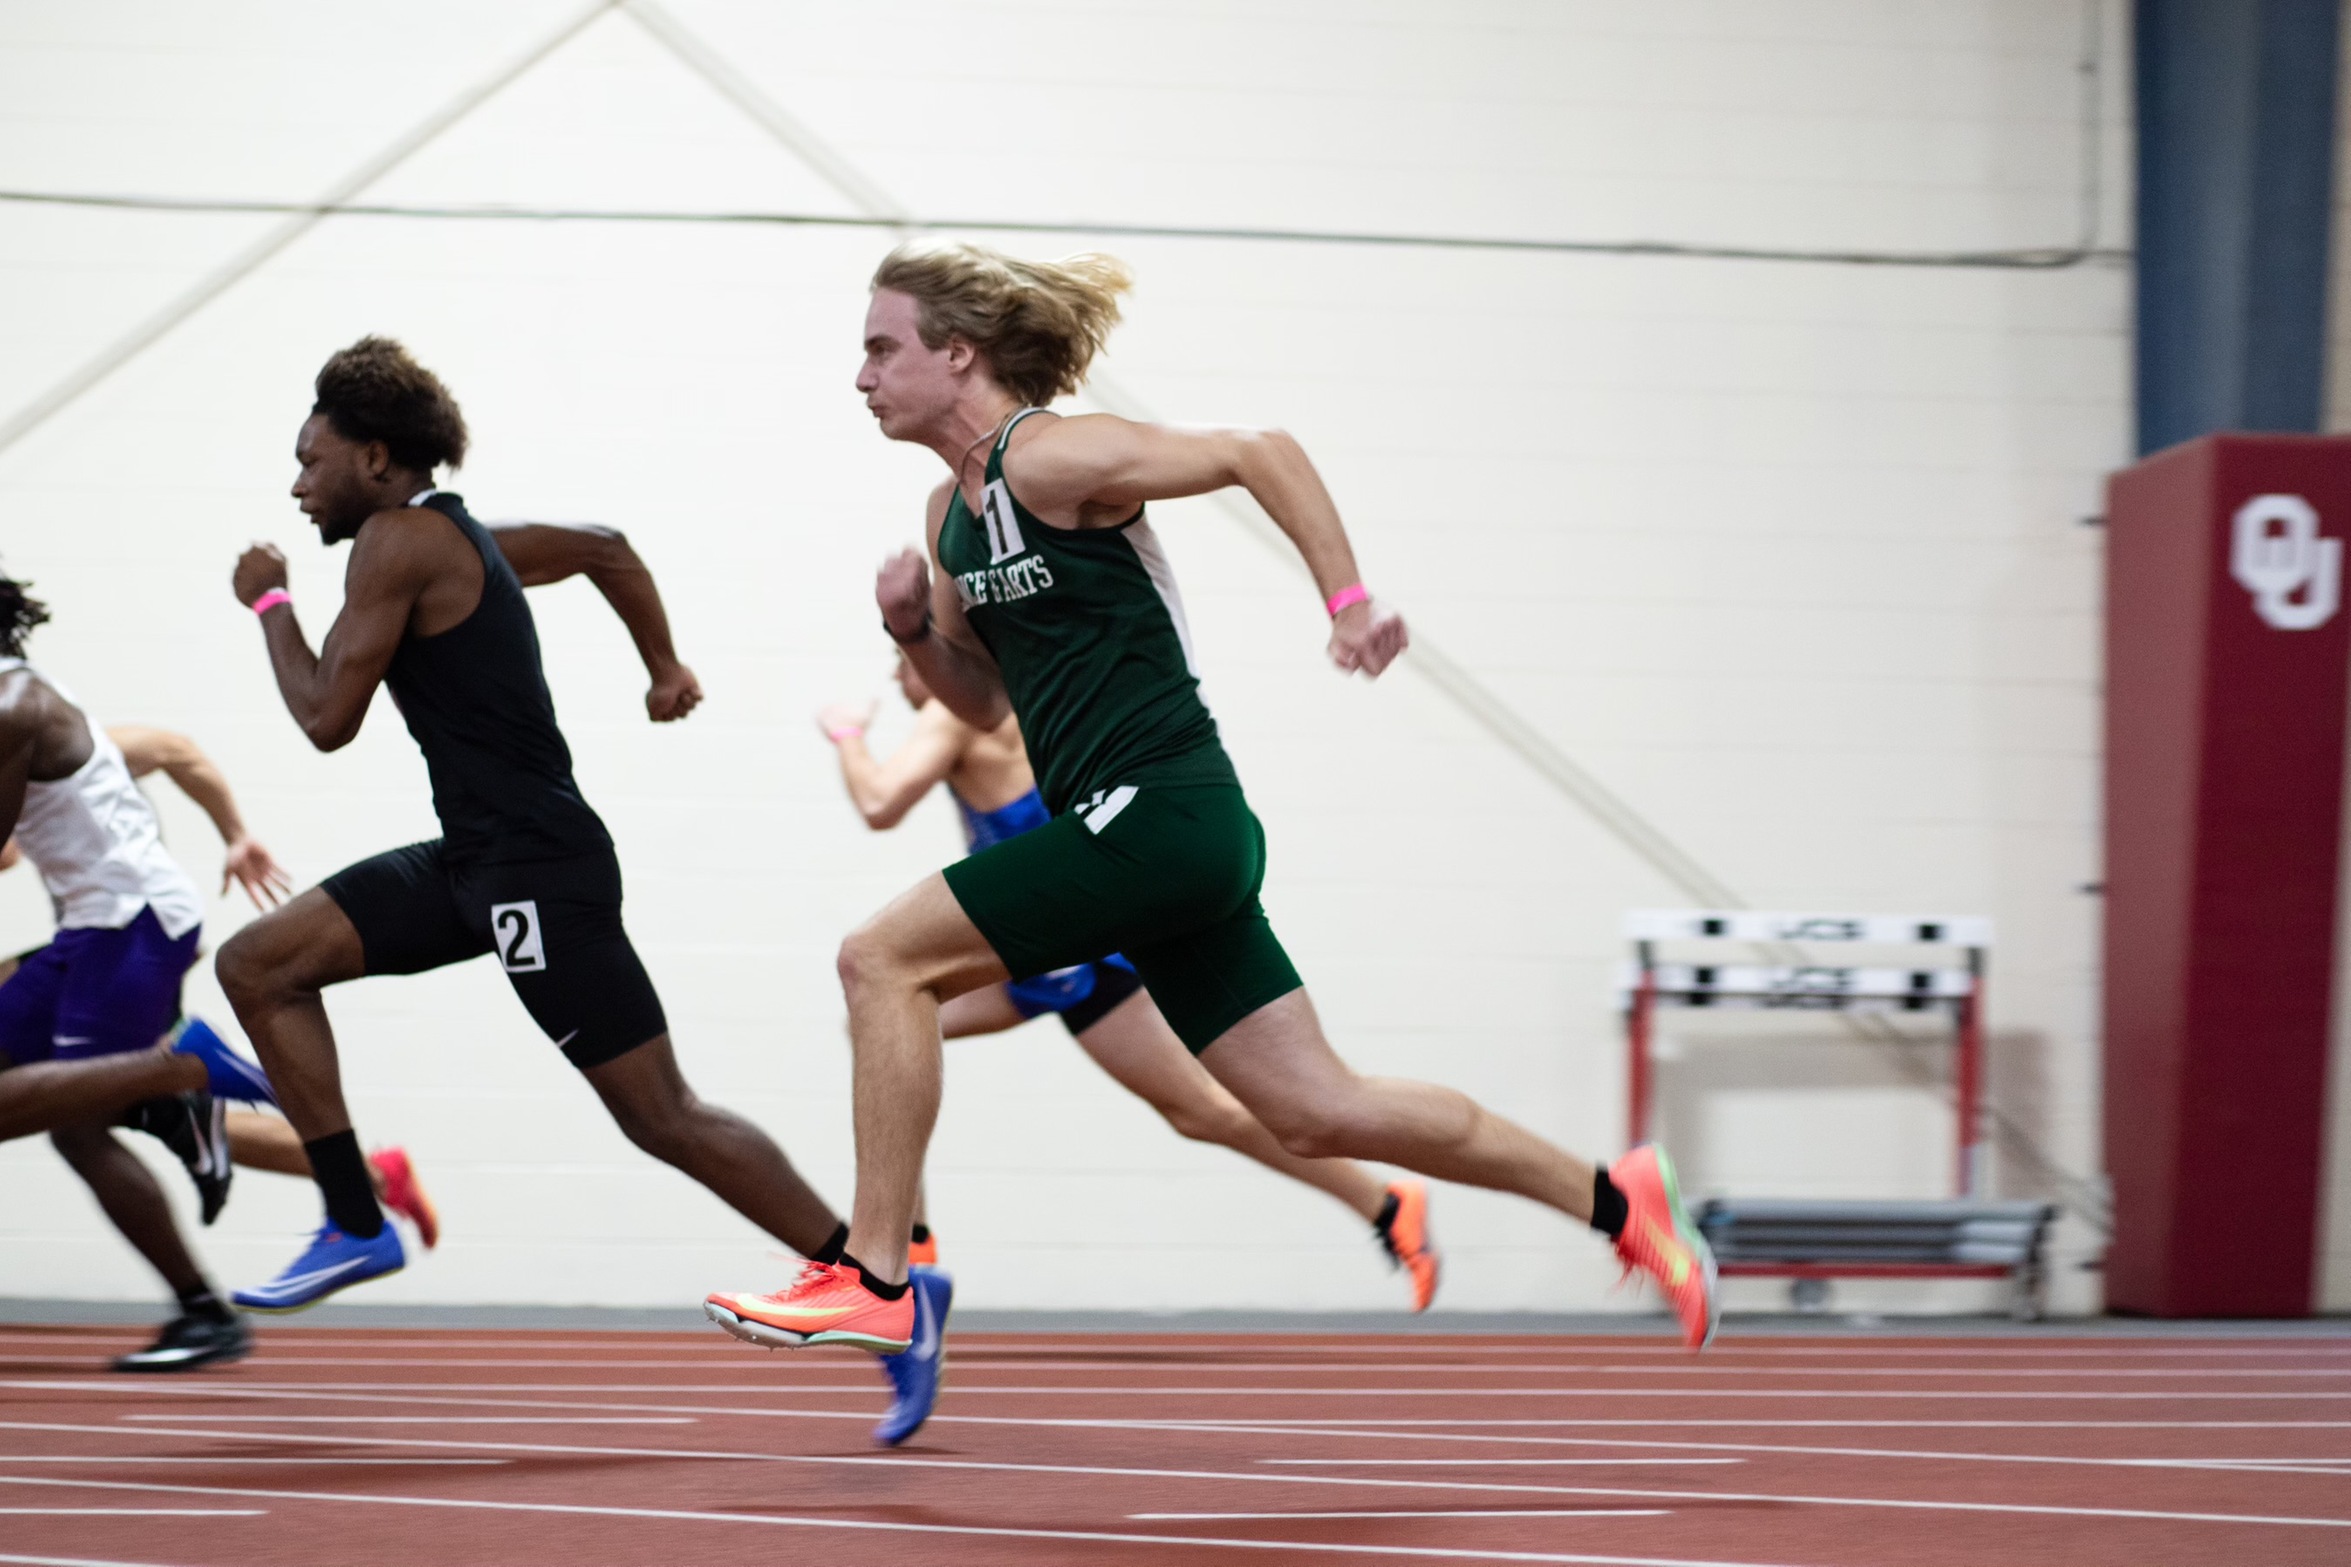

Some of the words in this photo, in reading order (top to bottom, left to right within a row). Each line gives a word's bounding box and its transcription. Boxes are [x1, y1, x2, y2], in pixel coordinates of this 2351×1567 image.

[986, 489, 1009, 555] 1
[996, 554, 1054, 602] ARTS
[2230, 494, 2344, 630] OU
[498, 909, 536, 967] 2
